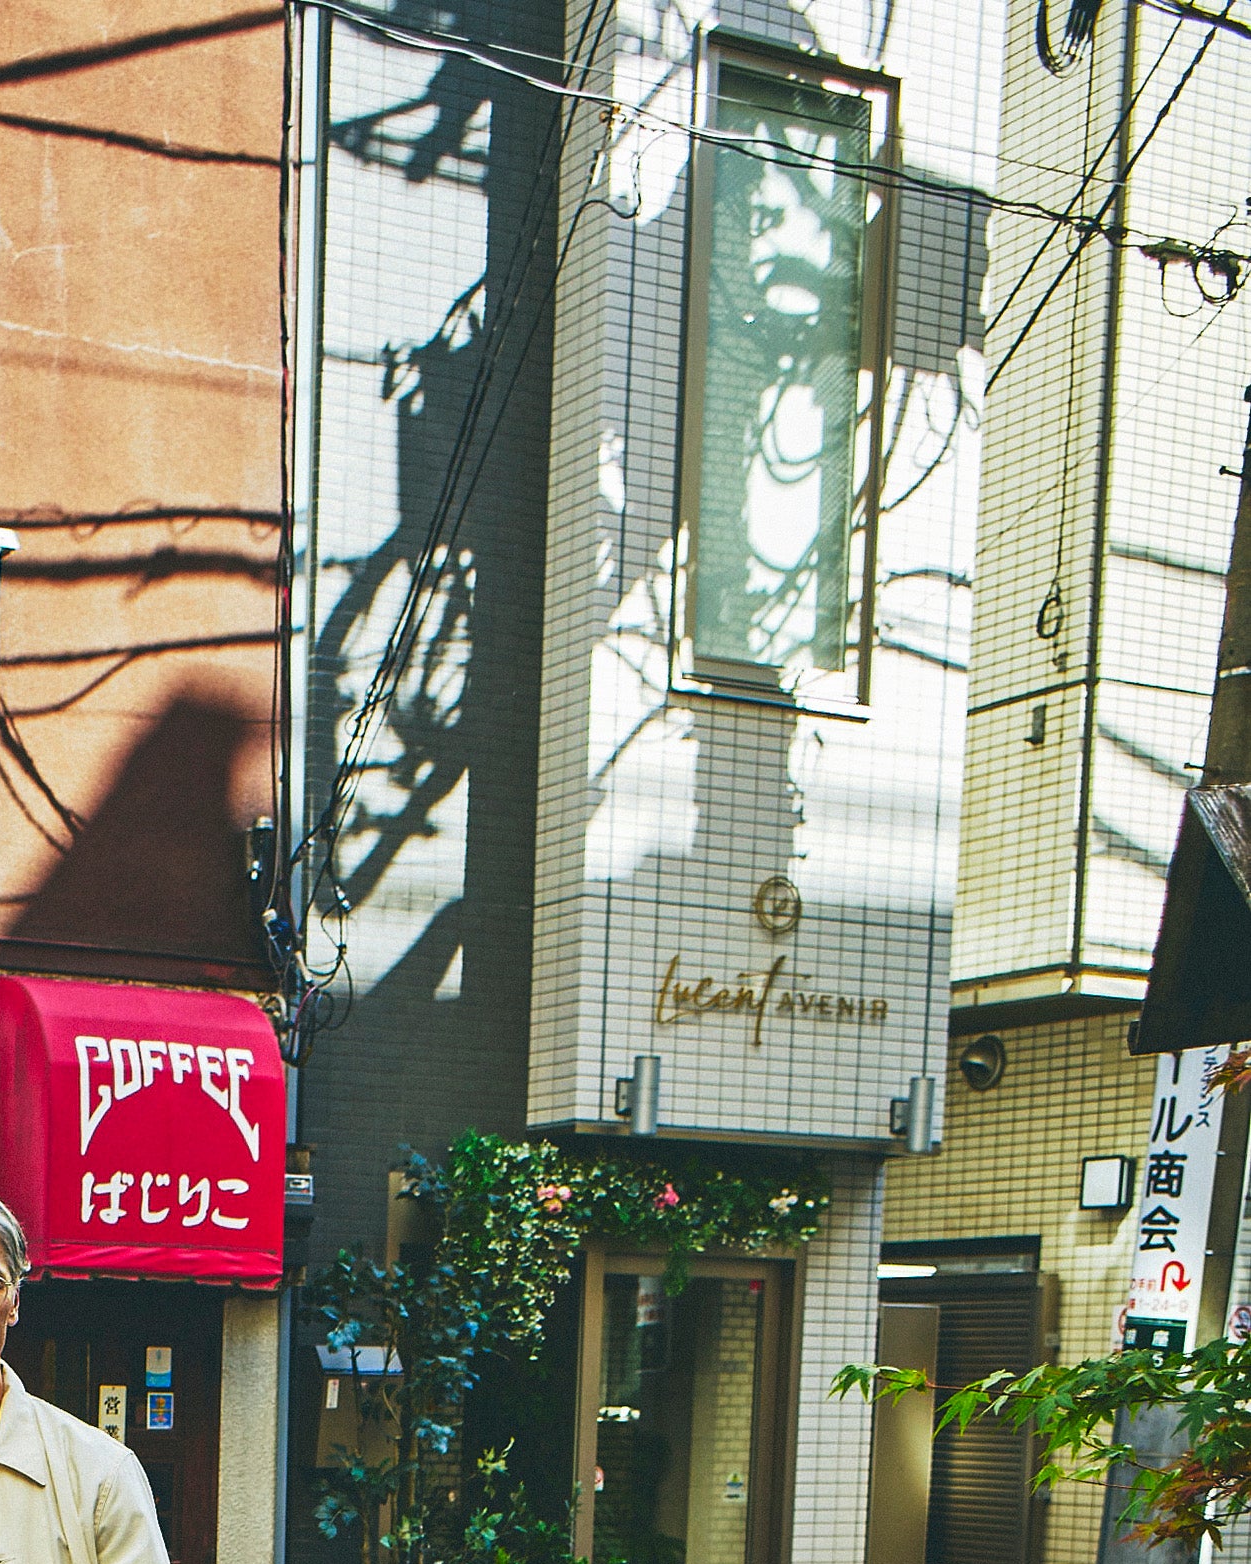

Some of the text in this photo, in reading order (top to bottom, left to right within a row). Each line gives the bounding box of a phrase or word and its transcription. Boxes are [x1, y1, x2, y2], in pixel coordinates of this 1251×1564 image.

[775, 991, 889, 1020] AVENIR
[75, 1035, 260, 1162] COFFEE
[81, 1171, 250, 1230] ばじりこ
